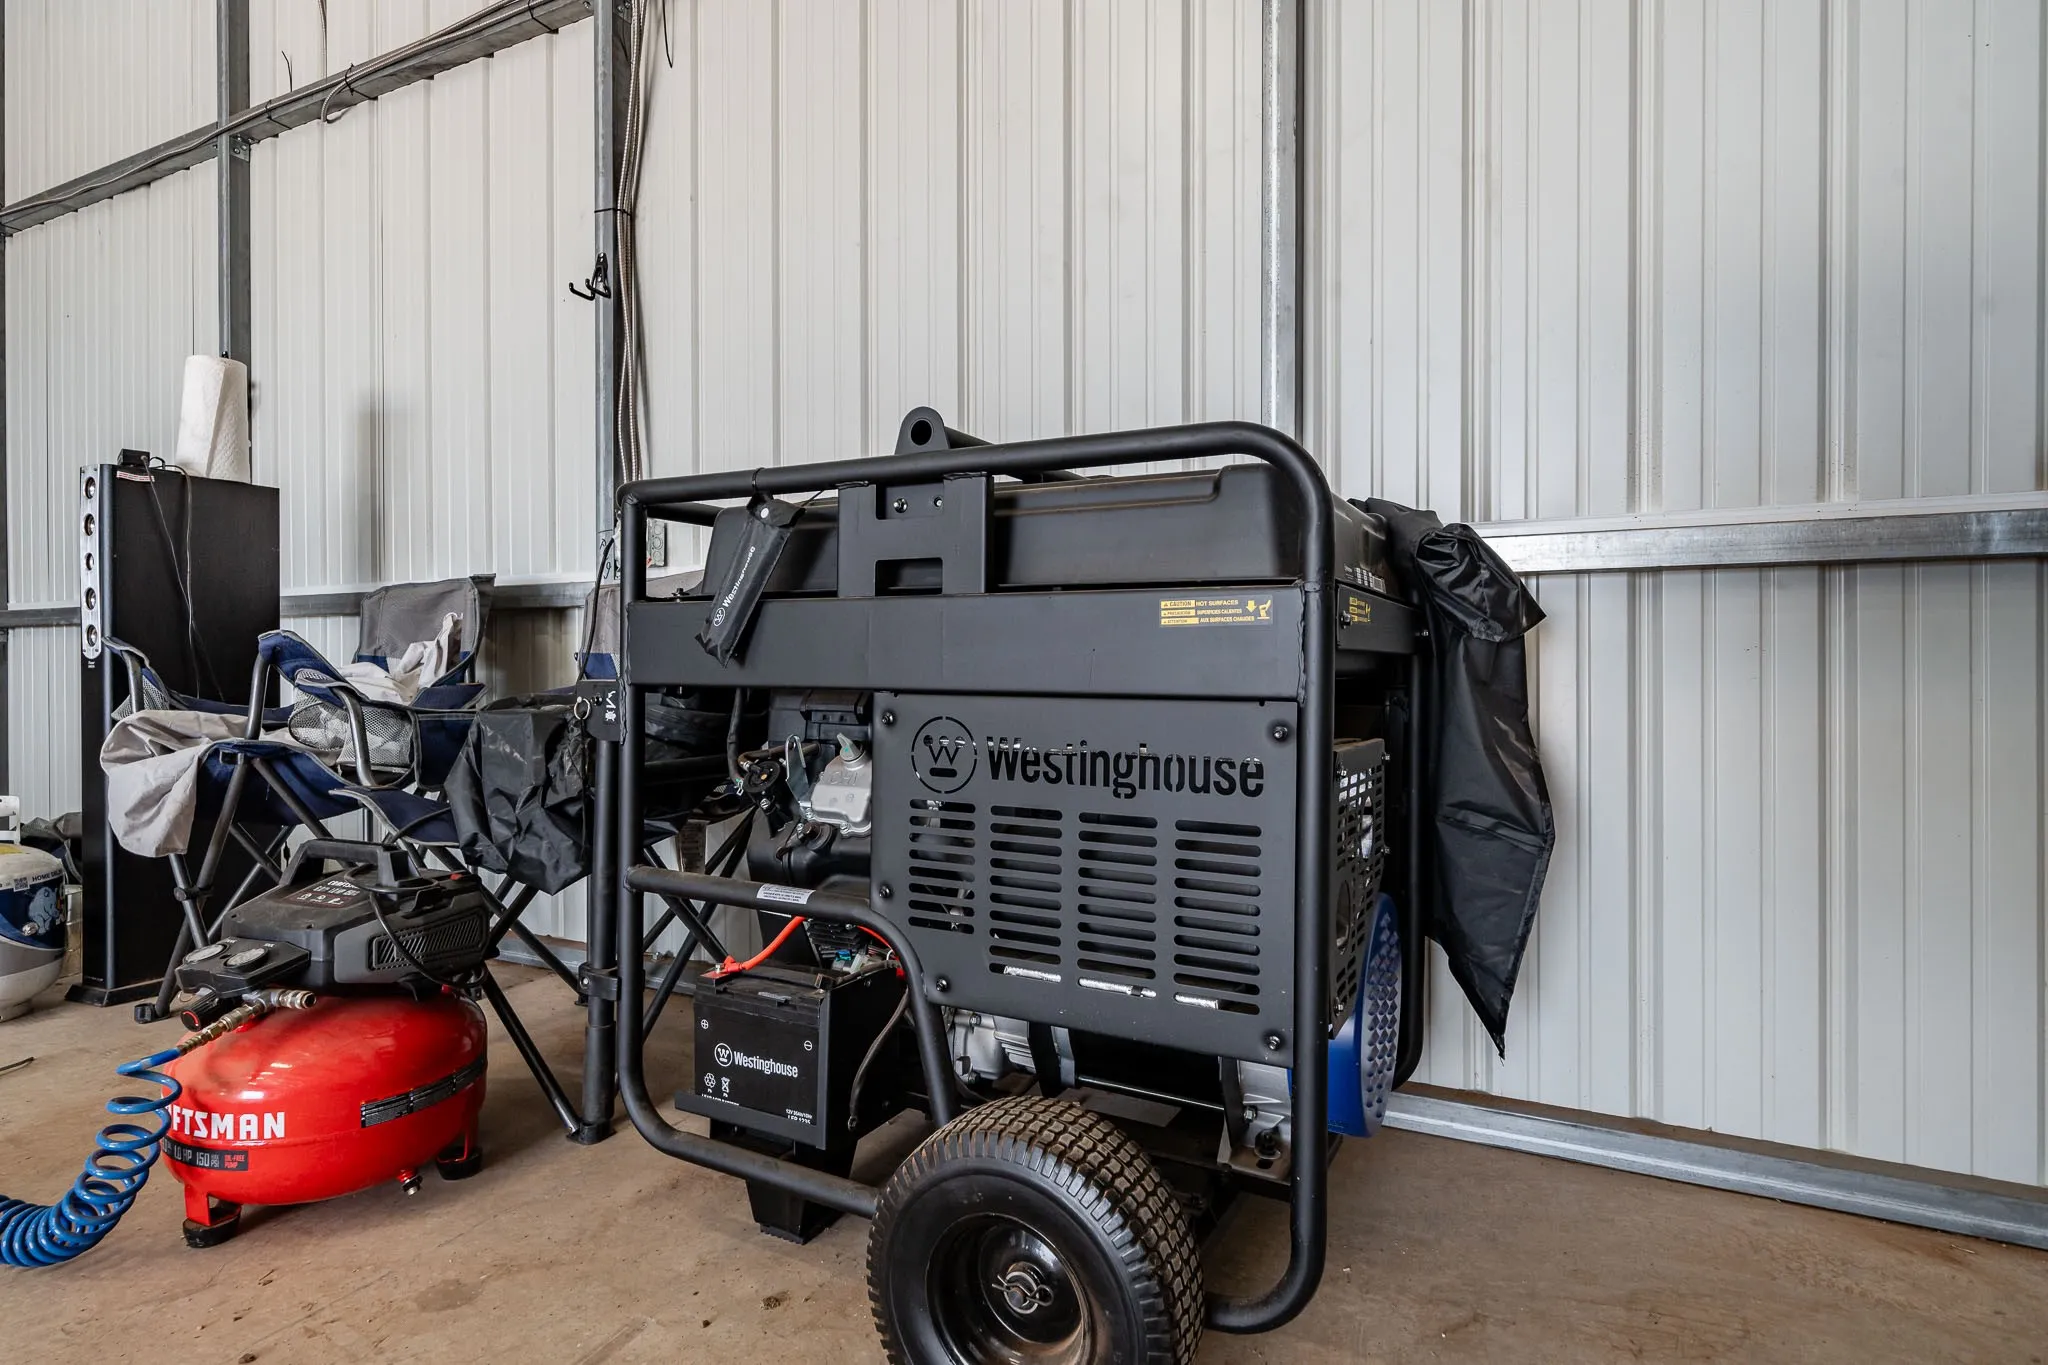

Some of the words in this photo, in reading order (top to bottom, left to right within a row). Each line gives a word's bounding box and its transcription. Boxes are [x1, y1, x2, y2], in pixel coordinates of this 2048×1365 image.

[722, 546, 755, 607] Westinghouse
[986, 736, 1264, 799] Westinghouse
[734, 1051, 798, 1078] Westinghouse
[166, 1104, 285, 1139] FTSMAN
[196, 1151, 209, 1167] 150
[210, 1159, 220, 1168] PSI
[224, 1154, 245, 1162] OIL-FREE
